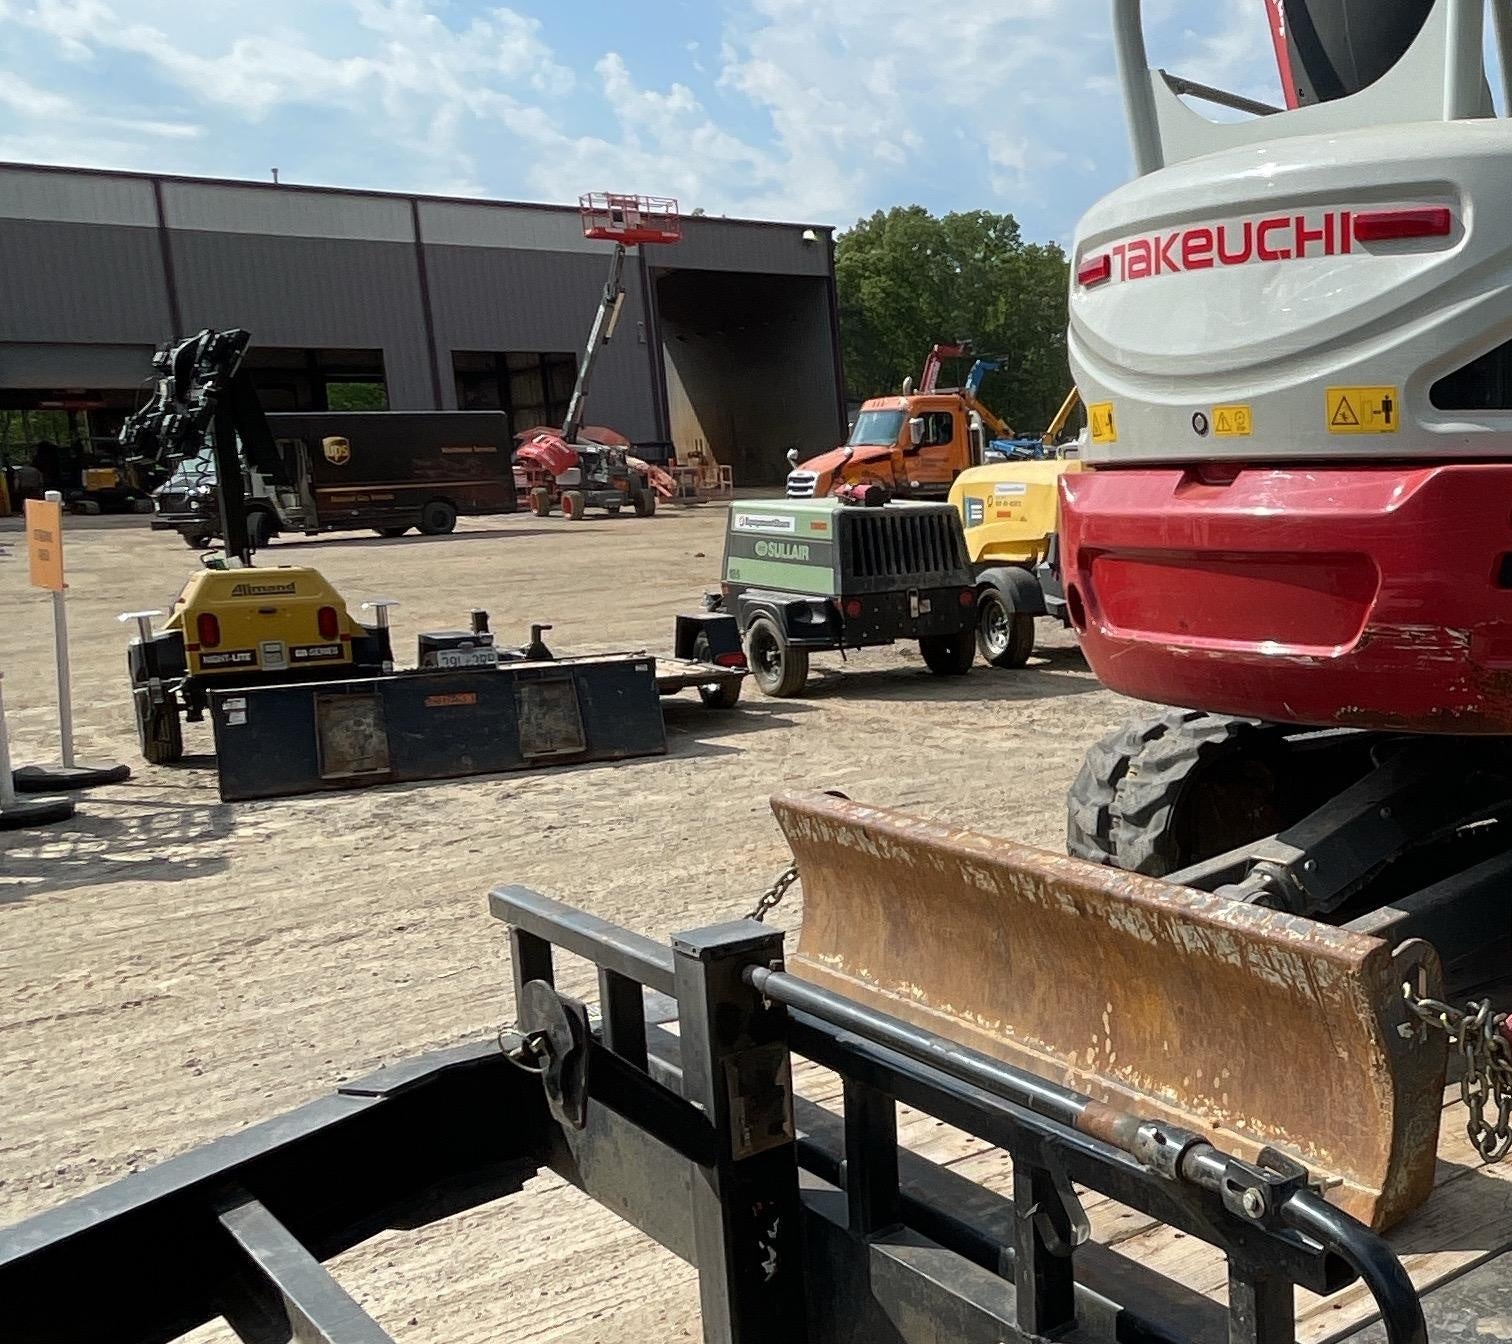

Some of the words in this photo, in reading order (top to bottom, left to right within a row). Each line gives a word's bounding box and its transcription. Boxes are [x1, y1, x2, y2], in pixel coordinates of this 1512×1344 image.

[1112, 211, 1352, 283] TAKEUCHI
[767, 541, 810, 561] SULLAIR
[232, 582, 296, 597] Allmand
